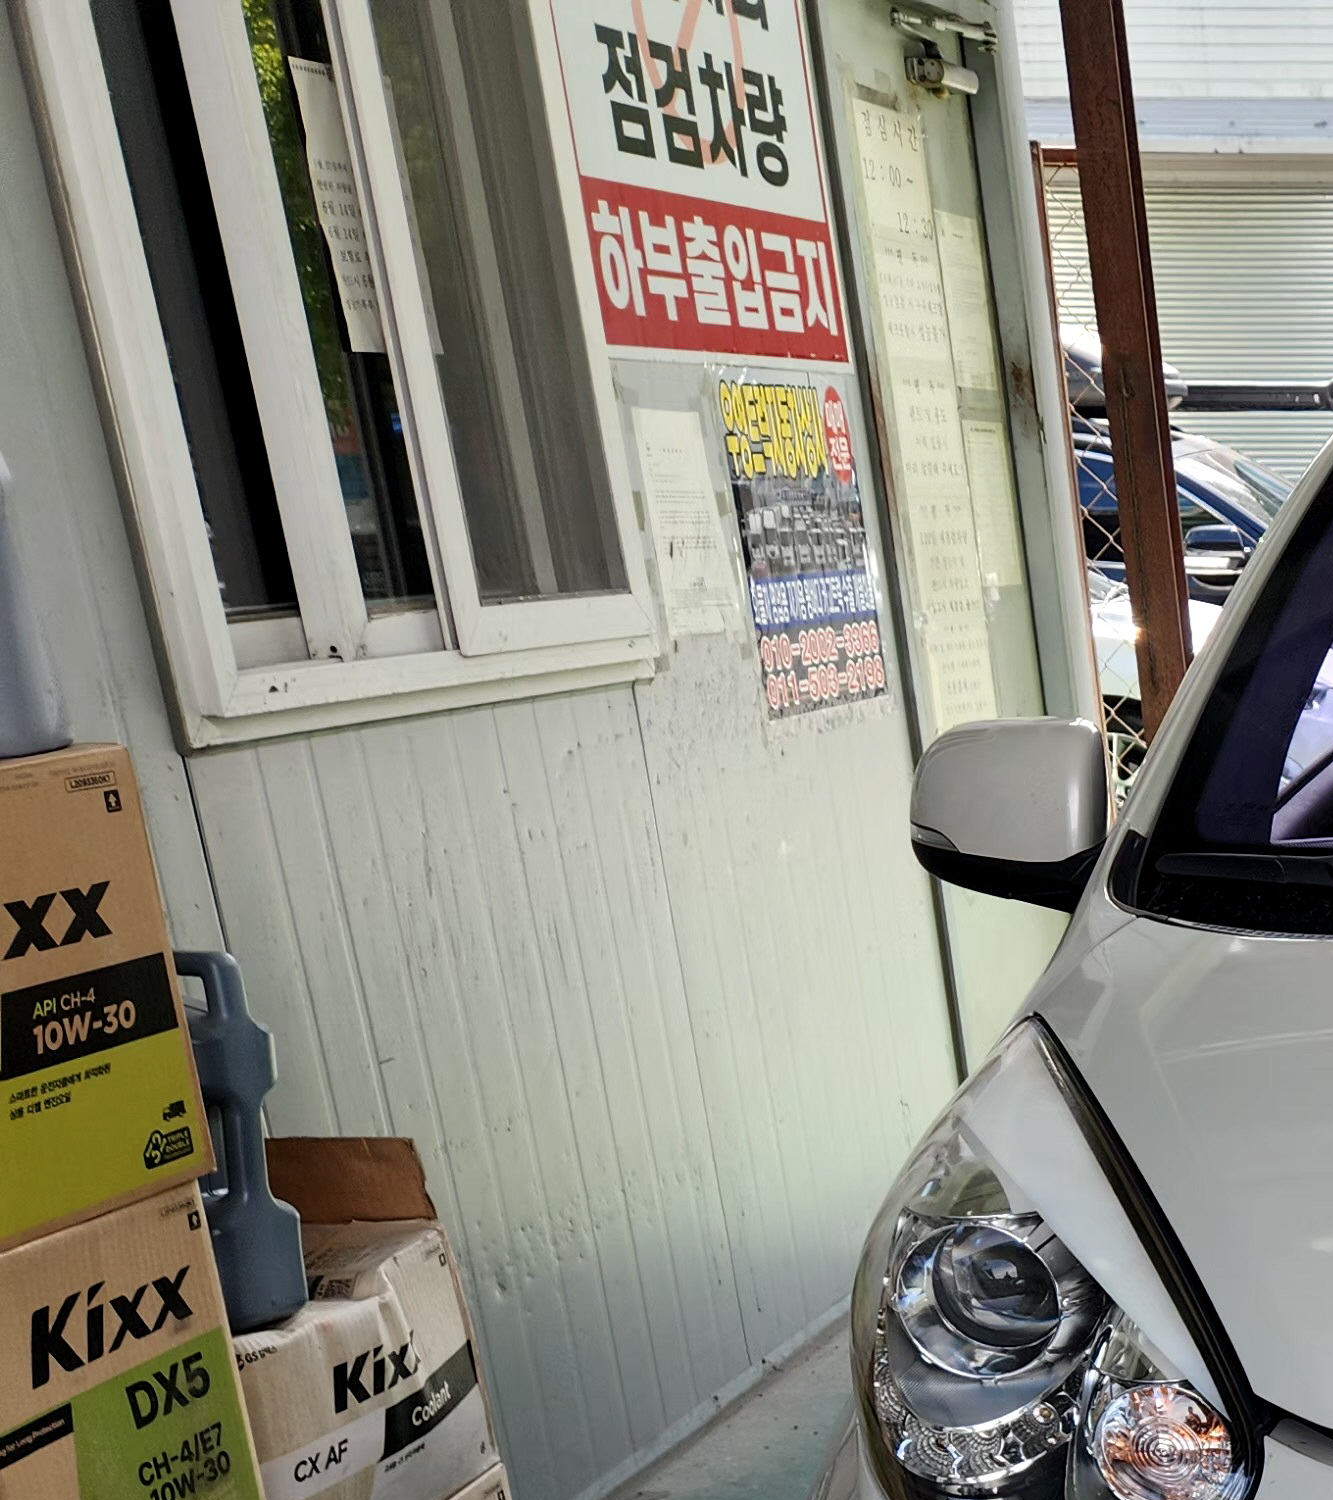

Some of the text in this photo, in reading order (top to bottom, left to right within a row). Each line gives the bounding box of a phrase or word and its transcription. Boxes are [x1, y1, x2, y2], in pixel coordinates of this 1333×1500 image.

[594, 23, 789, 187] 점검차량
[591, 200, 838, 336] 하부출입금지
[761, 620, 879, 672] 010-2002-3366
[767, 655, 885, 710] 011-503-2198
[33, 987, 96, 1020] API CH-4
[33, 1000, 136, 1055] 10W-30
[31, 1265, 193, 1390] Kixx
[125, 1352, 210, 1430] DX5
[412, 1380, 451, 1427] Coolant
[138, 1421, 222, 1486] CH-4/E7
[294, 1439, 348, 1482] CX AF
